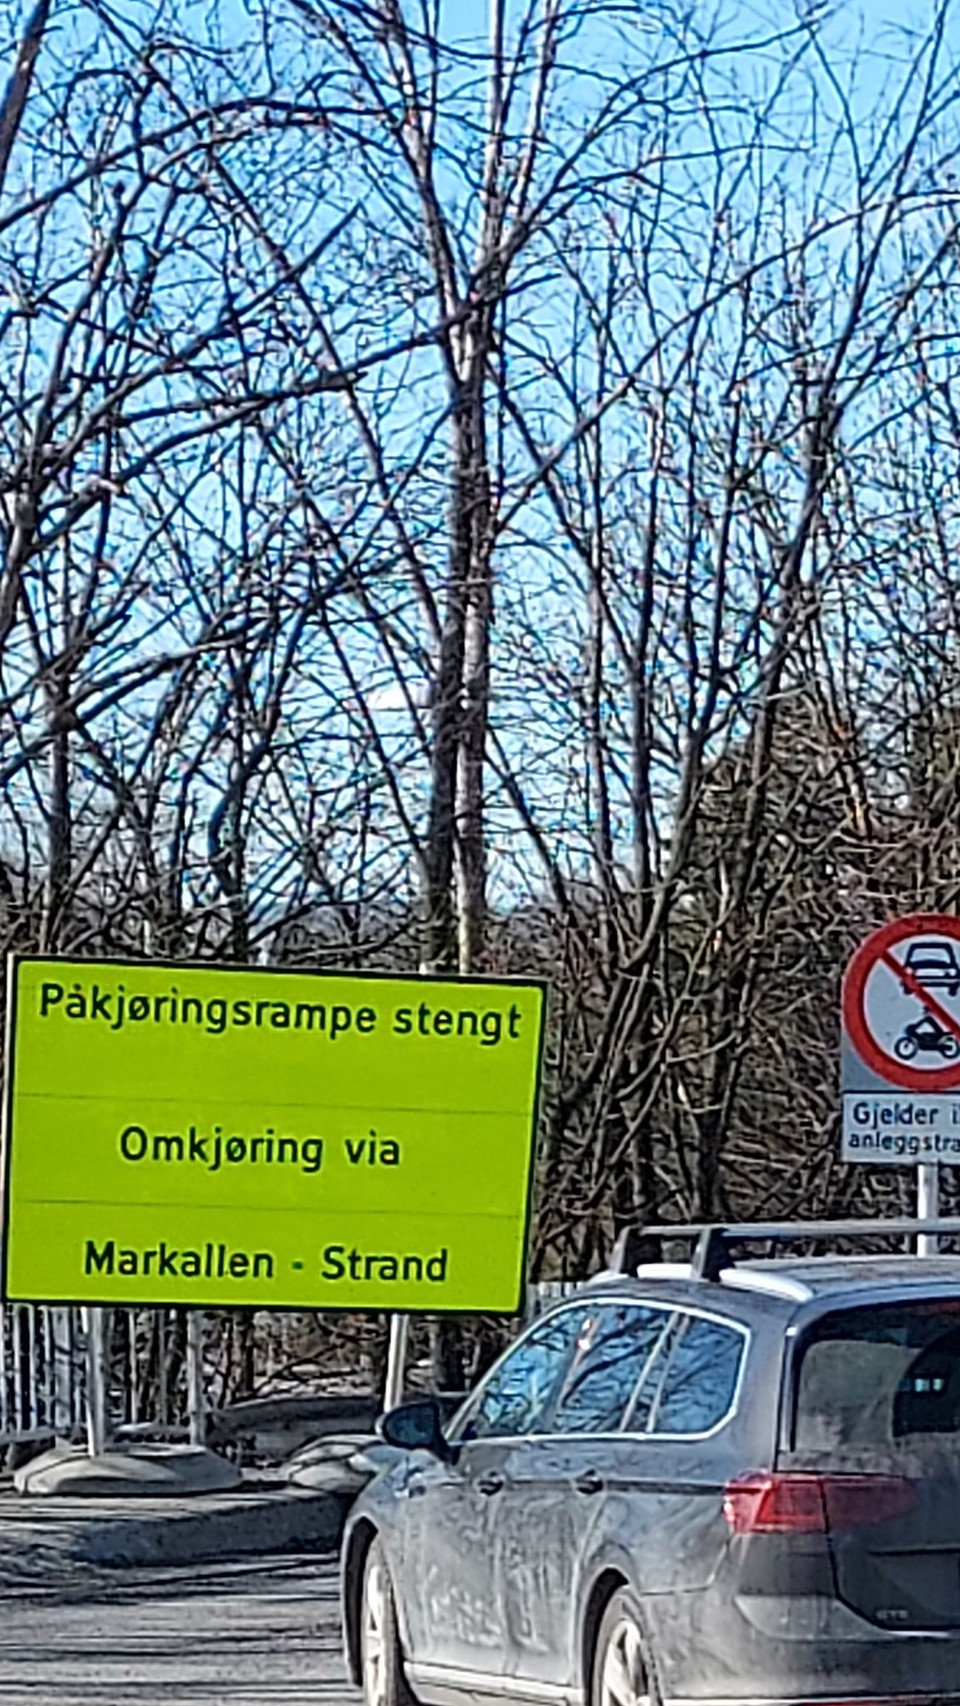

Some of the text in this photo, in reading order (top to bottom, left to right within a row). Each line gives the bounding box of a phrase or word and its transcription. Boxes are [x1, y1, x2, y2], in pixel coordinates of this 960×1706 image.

[39, 982, 523, 1045] Påkjøringsrampe stengt
[853, 1102, 938, 1129] Gjelder
[120, 1126, 401, 1172] Omkjøring via
[84, 1240, 273, 1278] Markallen
[321, 1245, 448, 1282] Strand
